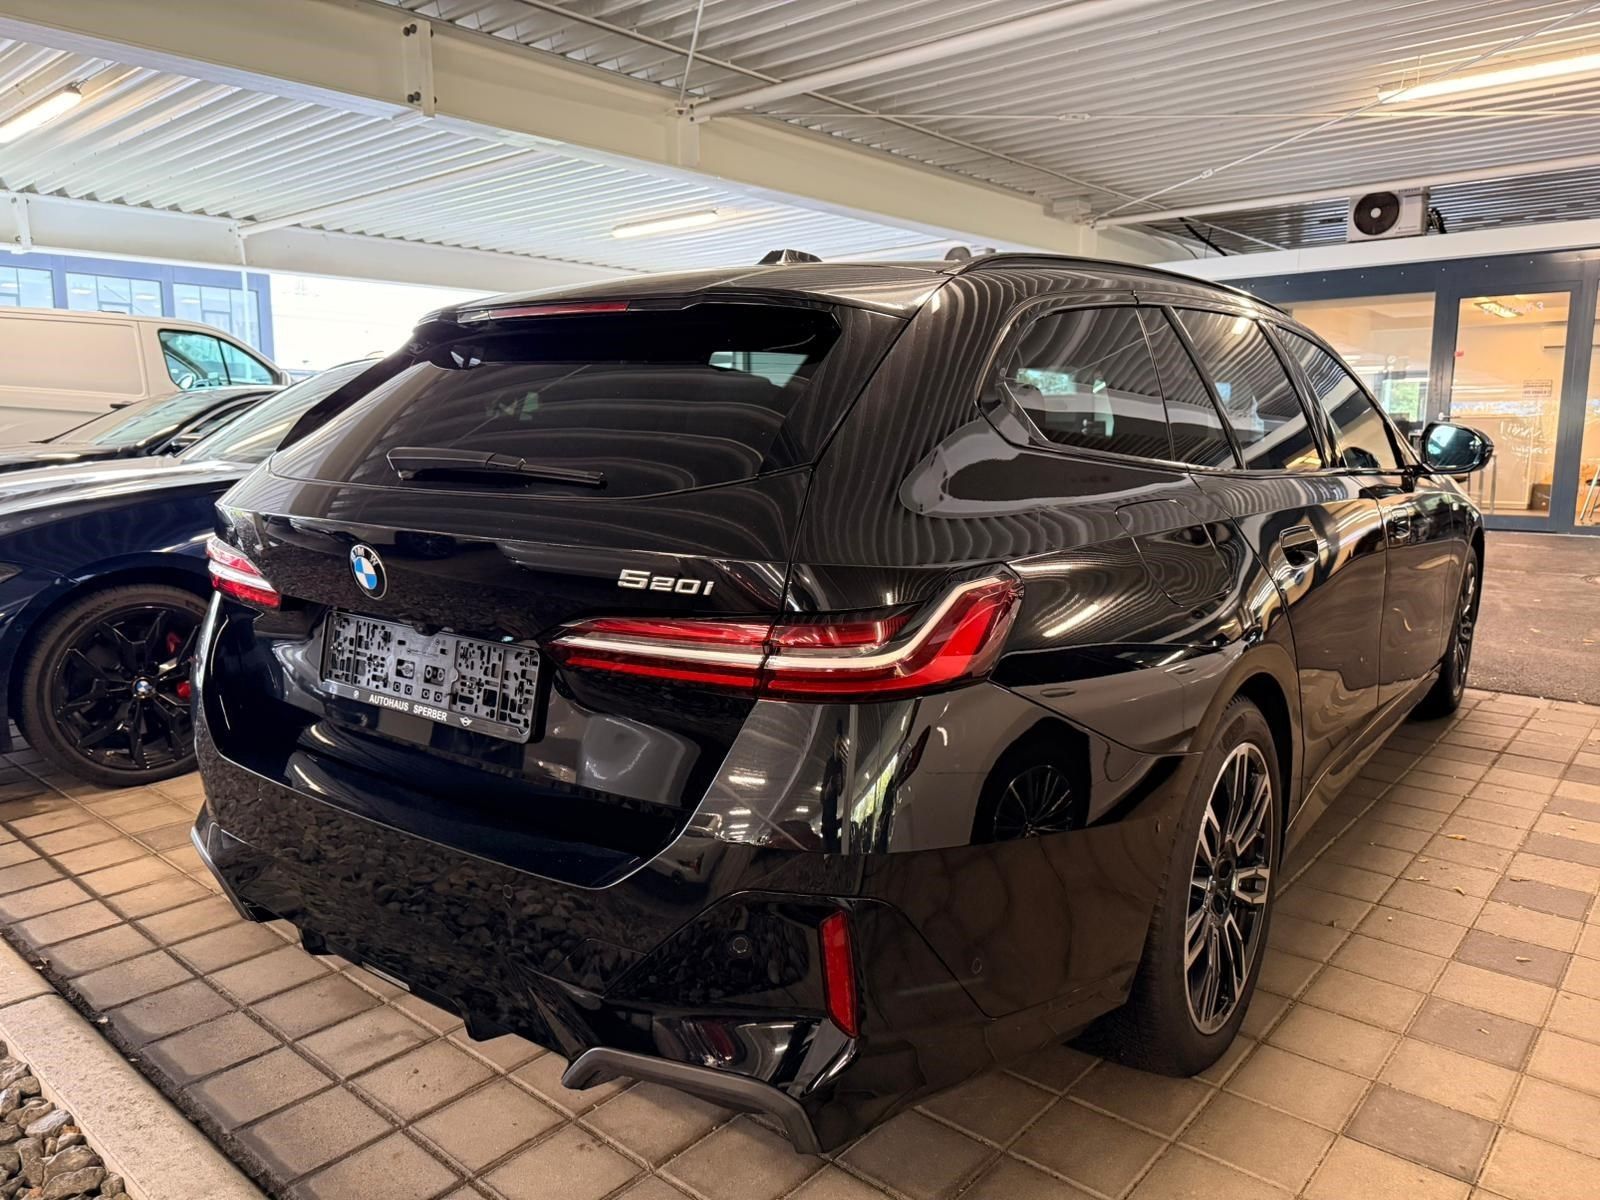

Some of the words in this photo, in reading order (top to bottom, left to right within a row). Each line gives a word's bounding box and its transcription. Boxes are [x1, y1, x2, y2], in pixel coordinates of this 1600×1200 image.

[617, 568, 715, 596] 520i
[368, 694, 409, 711] AUTOHAUS
[413, 704, 448, 721] SPERBER
